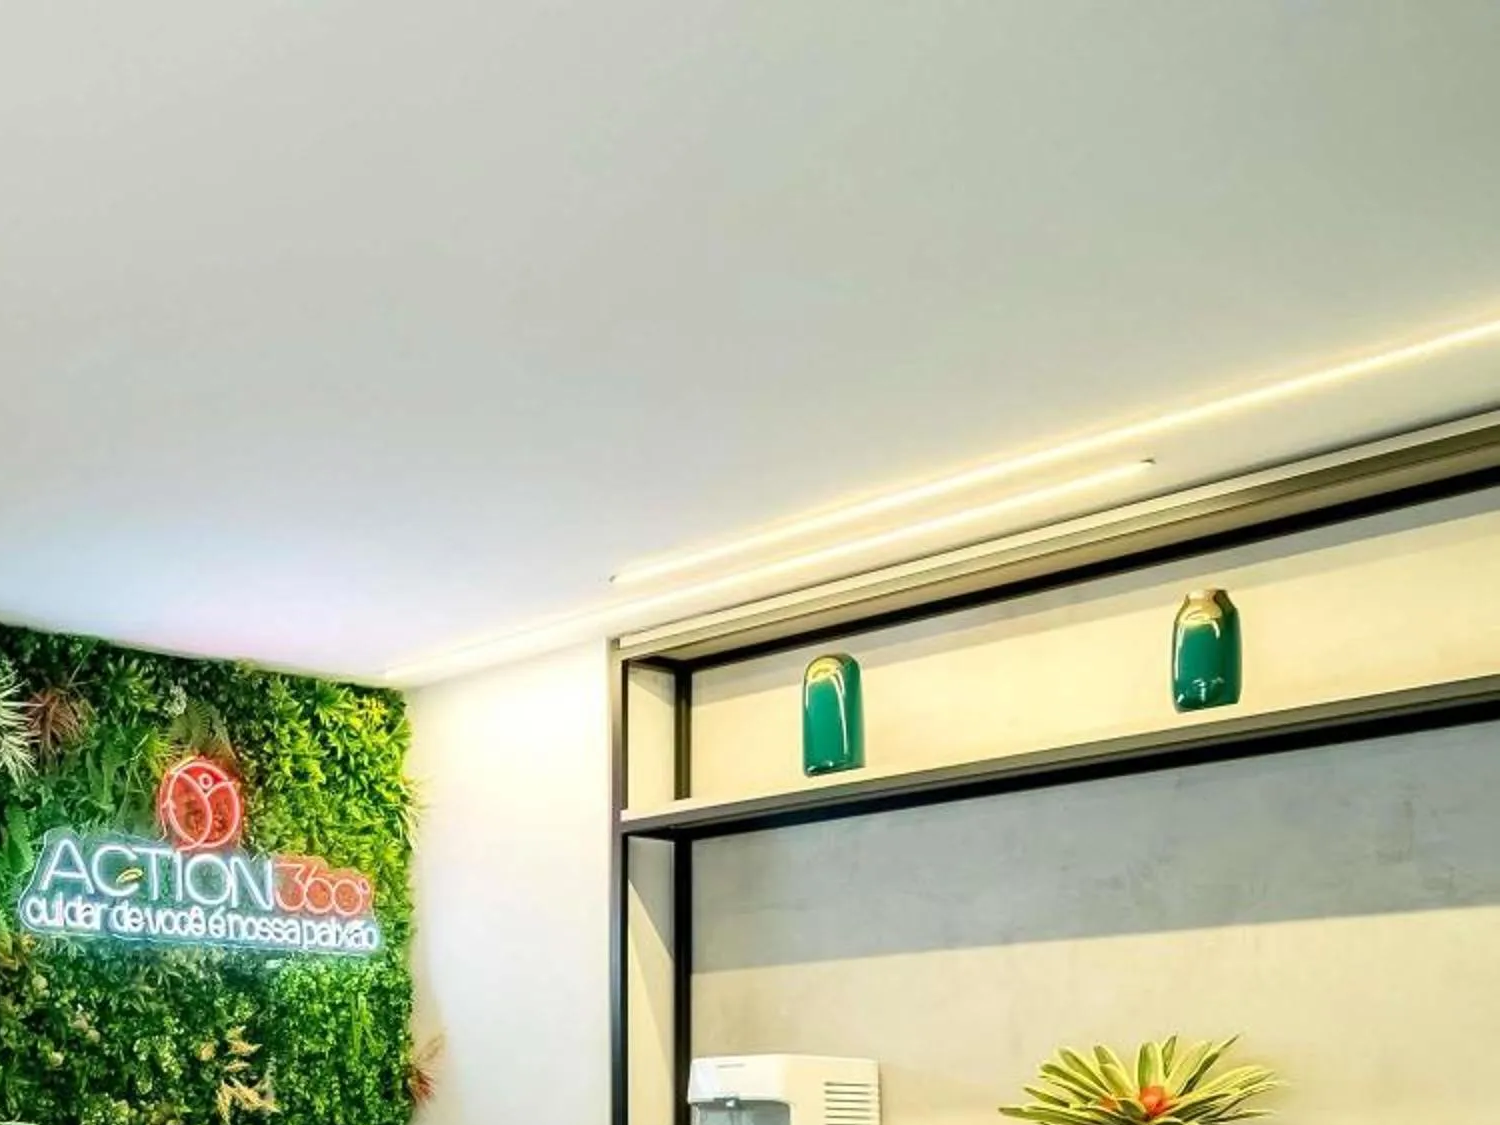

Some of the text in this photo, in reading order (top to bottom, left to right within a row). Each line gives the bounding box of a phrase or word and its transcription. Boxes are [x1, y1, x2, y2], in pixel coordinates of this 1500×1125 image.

[41, 838, 274, 912] ACTION
[26, 890, 378, 951] cuidar de você é nossa paixão
